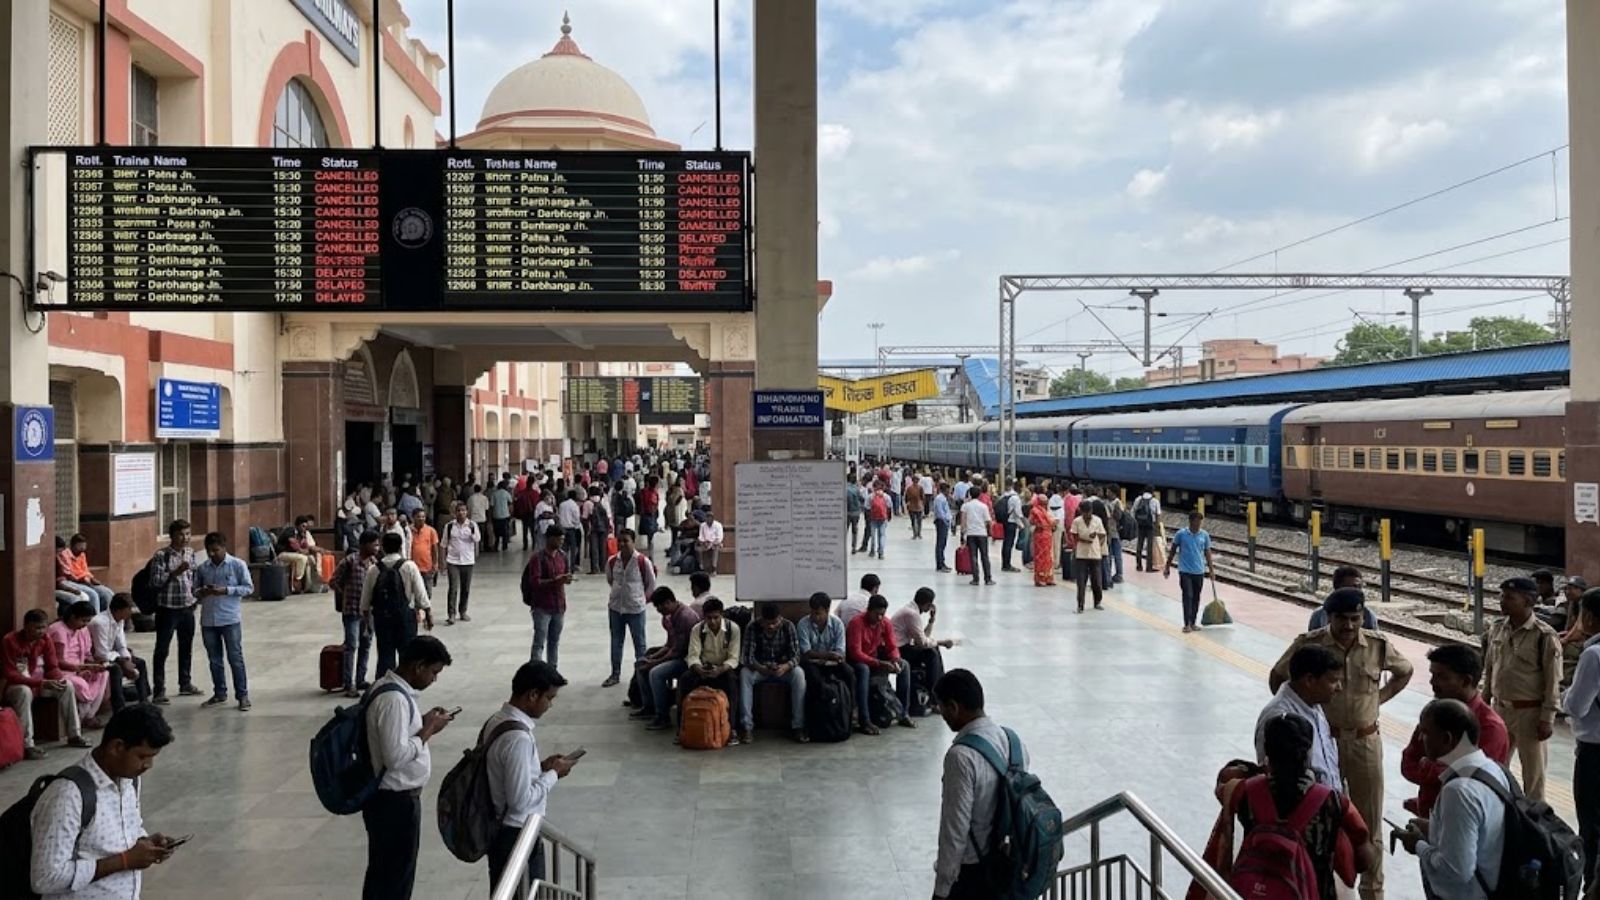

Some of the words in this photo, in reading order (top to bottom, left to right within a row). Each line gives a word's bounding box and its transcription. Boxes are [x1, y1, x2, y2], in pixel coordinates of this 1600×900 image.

[154, 156, 186, 165] Name
[273, 157, 300, 167] Time
[322, 158, 358, 168] Status
[525, 159, 557, 169] Name
[638, 160, 665, 169] Time
[686, 161, 721, 170] Status
[316, 269, 364, 278] DELAYED
[316, 293, 364, 302] DELAYED
